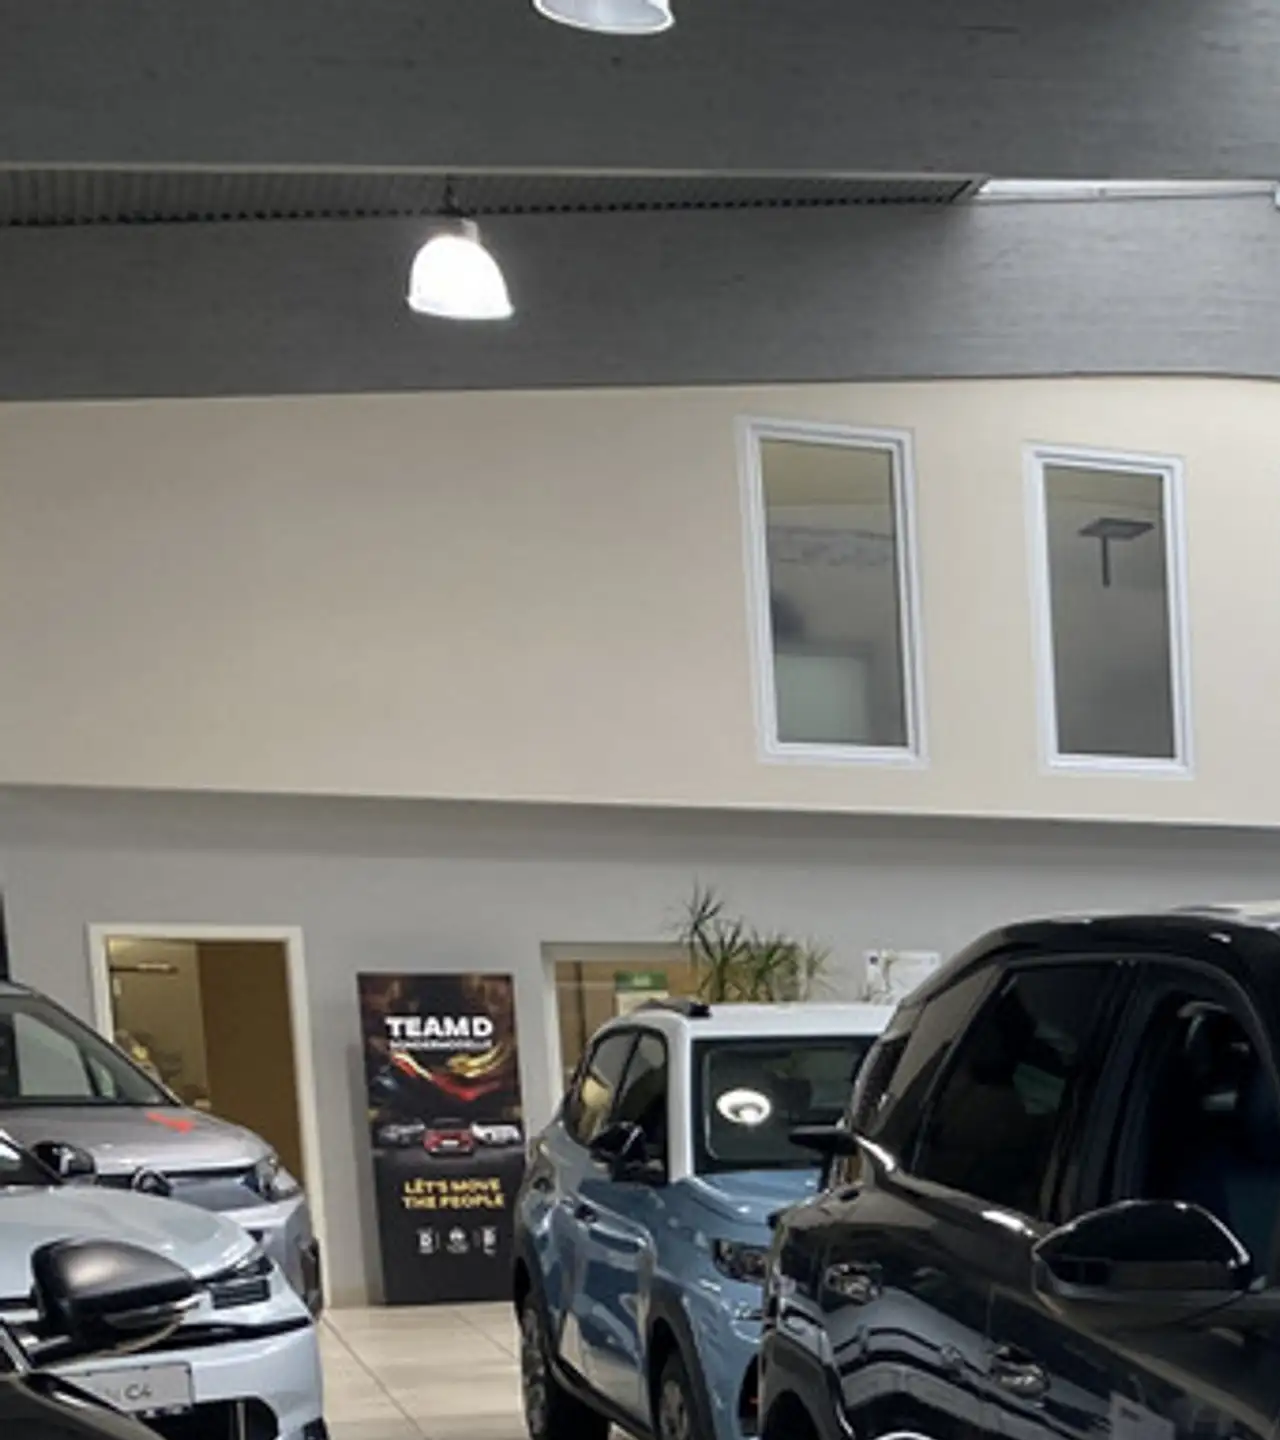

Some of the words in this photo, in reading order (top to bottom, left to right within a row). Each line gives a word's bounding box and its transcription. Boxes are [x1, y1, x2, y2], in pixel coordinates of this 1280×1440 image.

[450, 1178, 500, 1192] MOVE
[401, 1196, 437, 1209] THE
[439, 1194, 504, 1209] PEOPLE
[125, 1383, 152, 1400] C4
